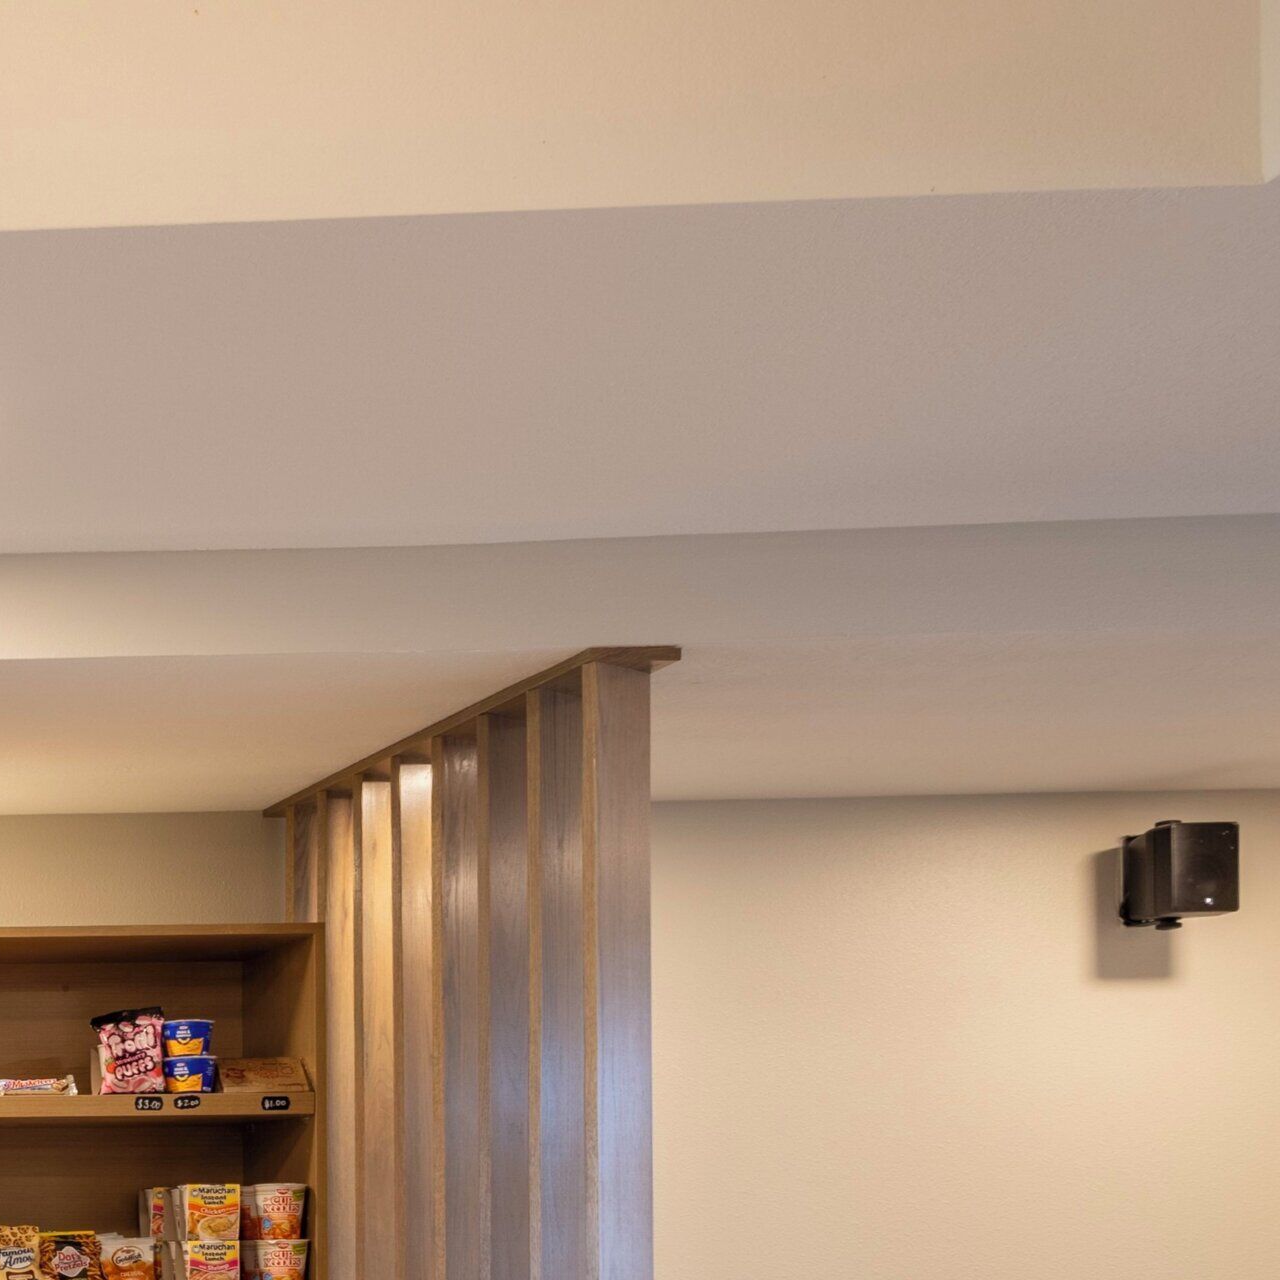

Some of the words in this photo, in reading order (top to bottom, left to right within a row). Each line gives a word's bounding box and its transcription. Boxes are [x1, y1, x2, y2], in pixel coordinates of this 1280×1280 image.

[115, 1056, 155, 1080] PUFFS
[137, 1099, 161, 1109] $3.00
[177, 1099, 199, 1108] $2.00
[264, 1100, 286, 1109] $1.00
[198, 1243, 236, 1251] Maruchan
[0, 1255, 34, 1270] Amos
[115, 1253, 143, 1265] Goldfish
[55, 1261, 88, 1272] Pretzels
